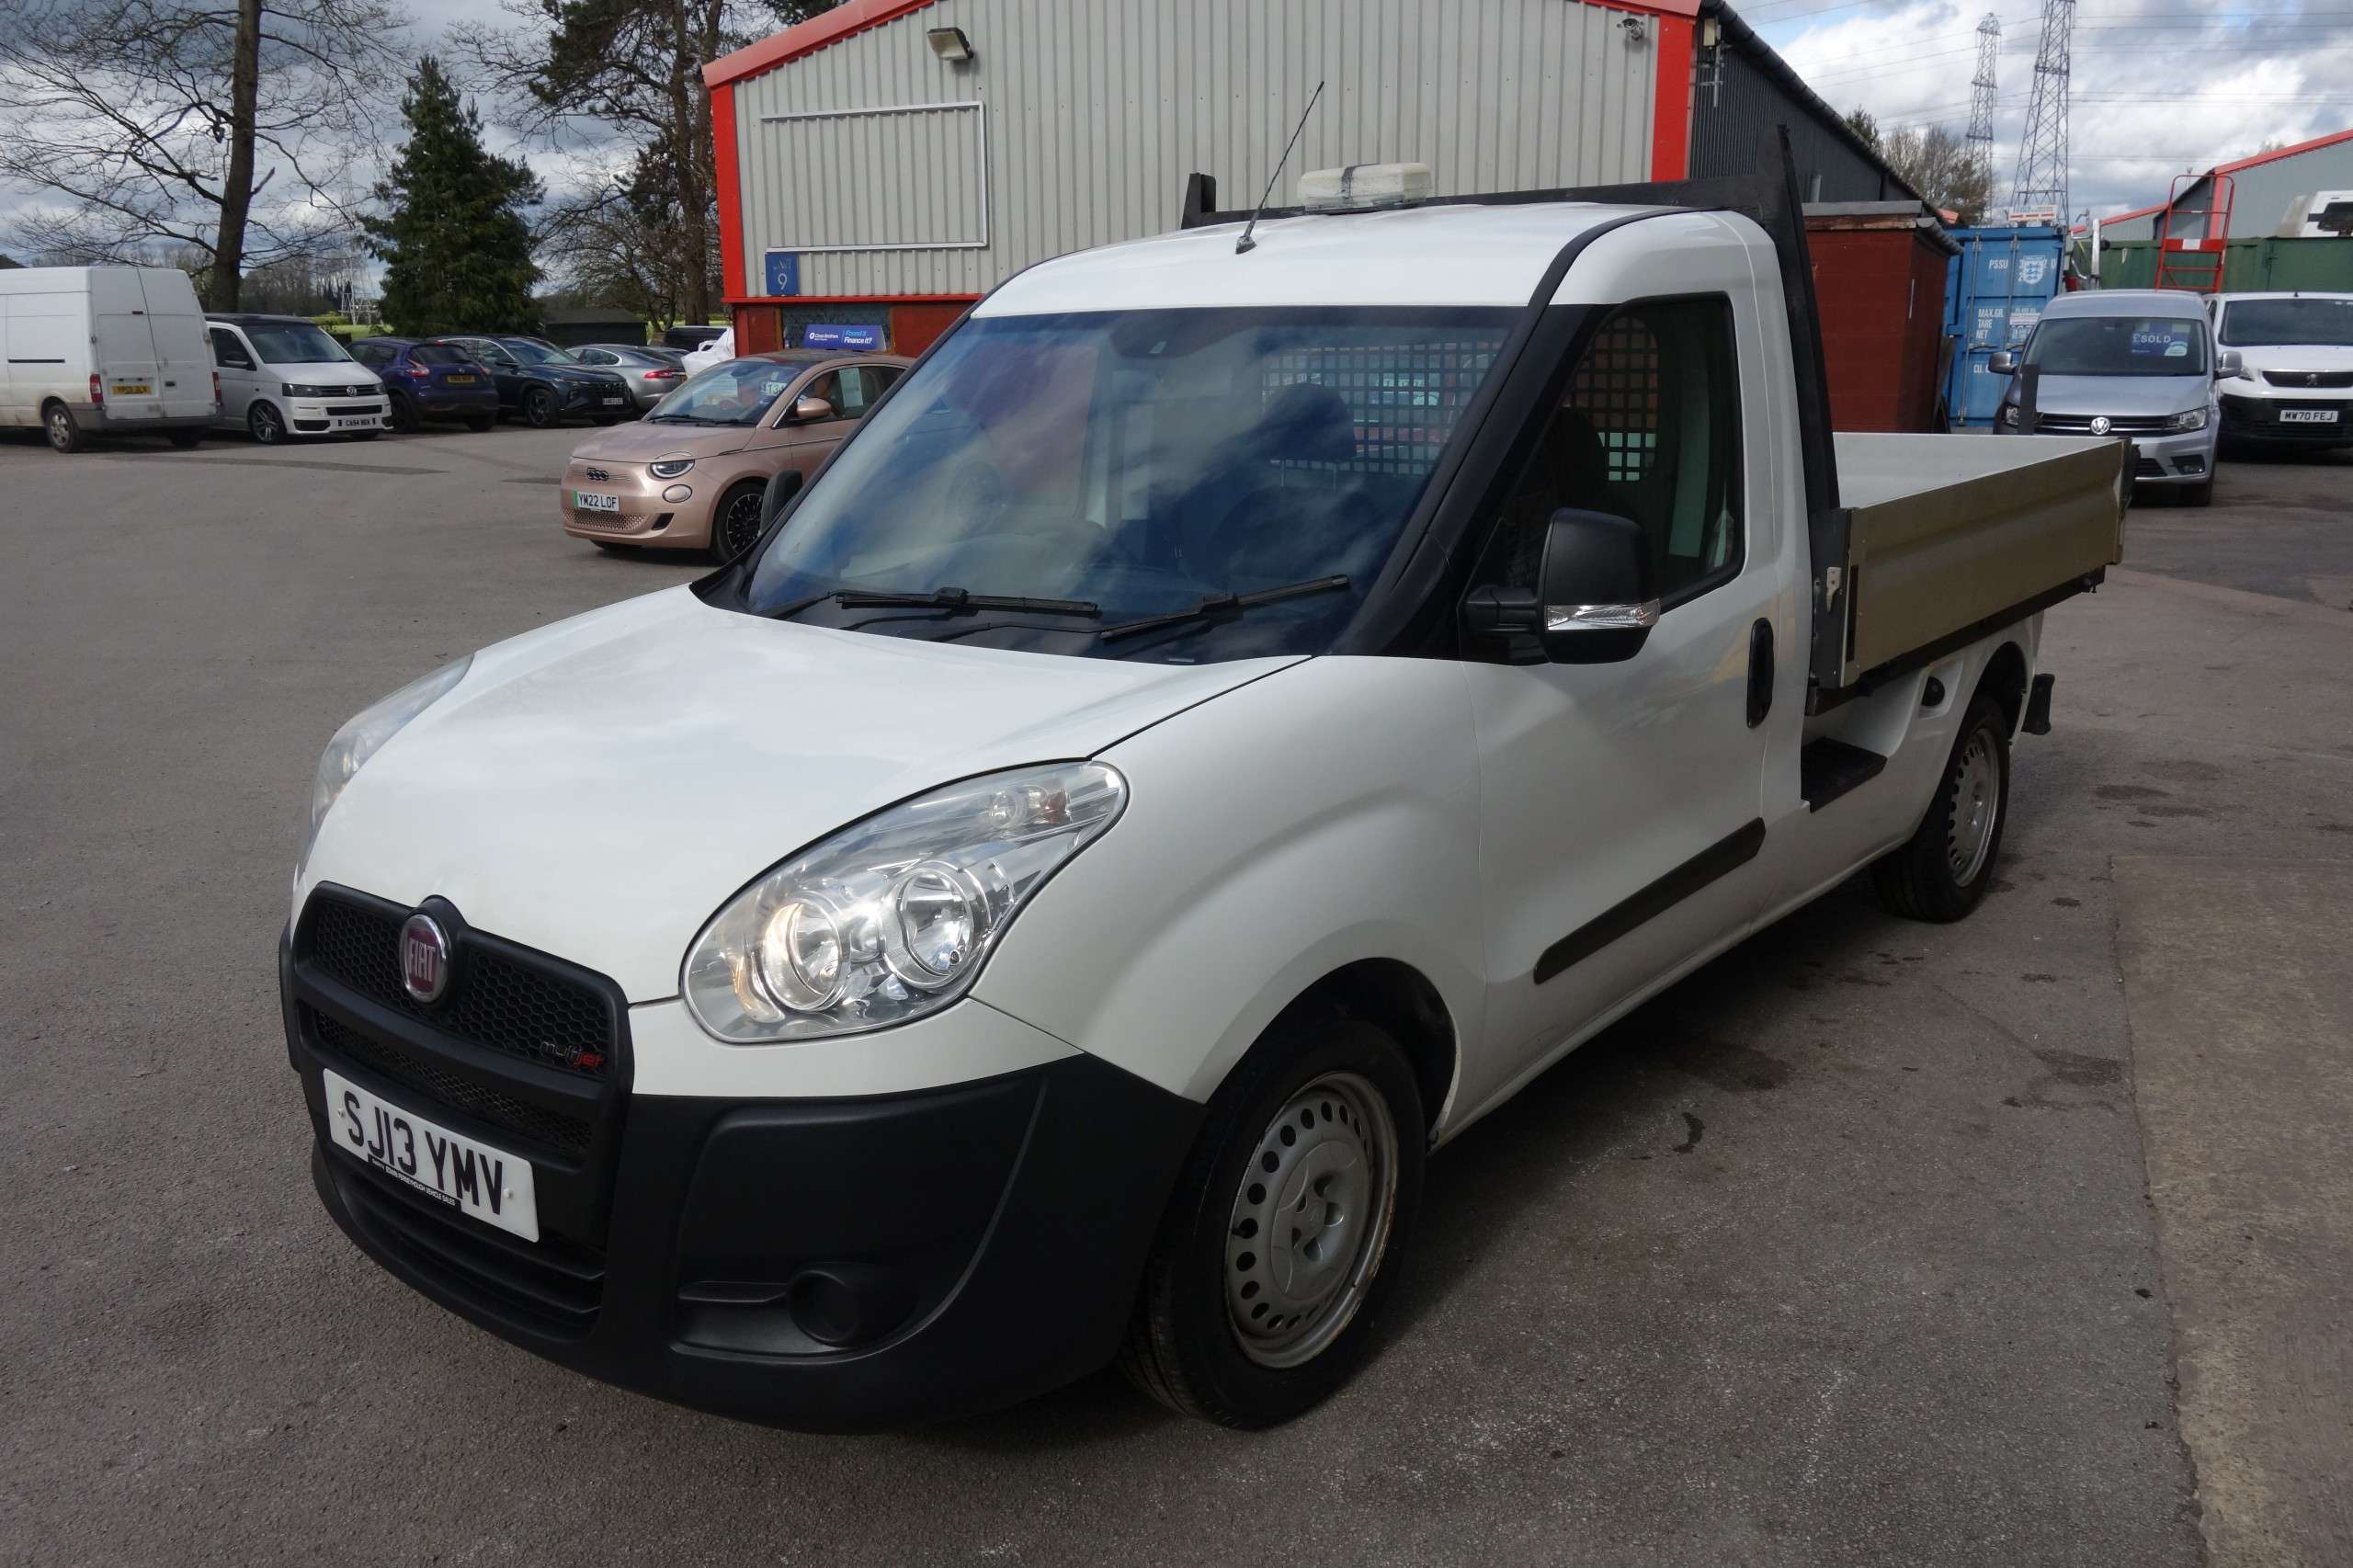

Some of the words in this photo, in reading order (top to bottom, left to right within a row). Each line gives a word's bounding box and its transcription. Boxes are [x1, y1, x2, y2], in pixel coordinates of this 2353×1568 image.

[1988, 259, 2008, 269] PSSU
[778, 273, 788, 290] 9
[1978, 318, 1993, 329] TARE
[1975, 329, 1989, 339] NET
[2284, 411, 2312, 421] MW70
[2313, 412, 2334, 421] FEJ
[578, 494, 599, 507] YM22
[600, 495, 617, 509] LOF
[408, 937, 437, 982] FIAT
[344, 1090, 417, 1176] SJ13
[425, 1130, 503, 1216] YMV
[442, 1195, 456, 1206] SALES
